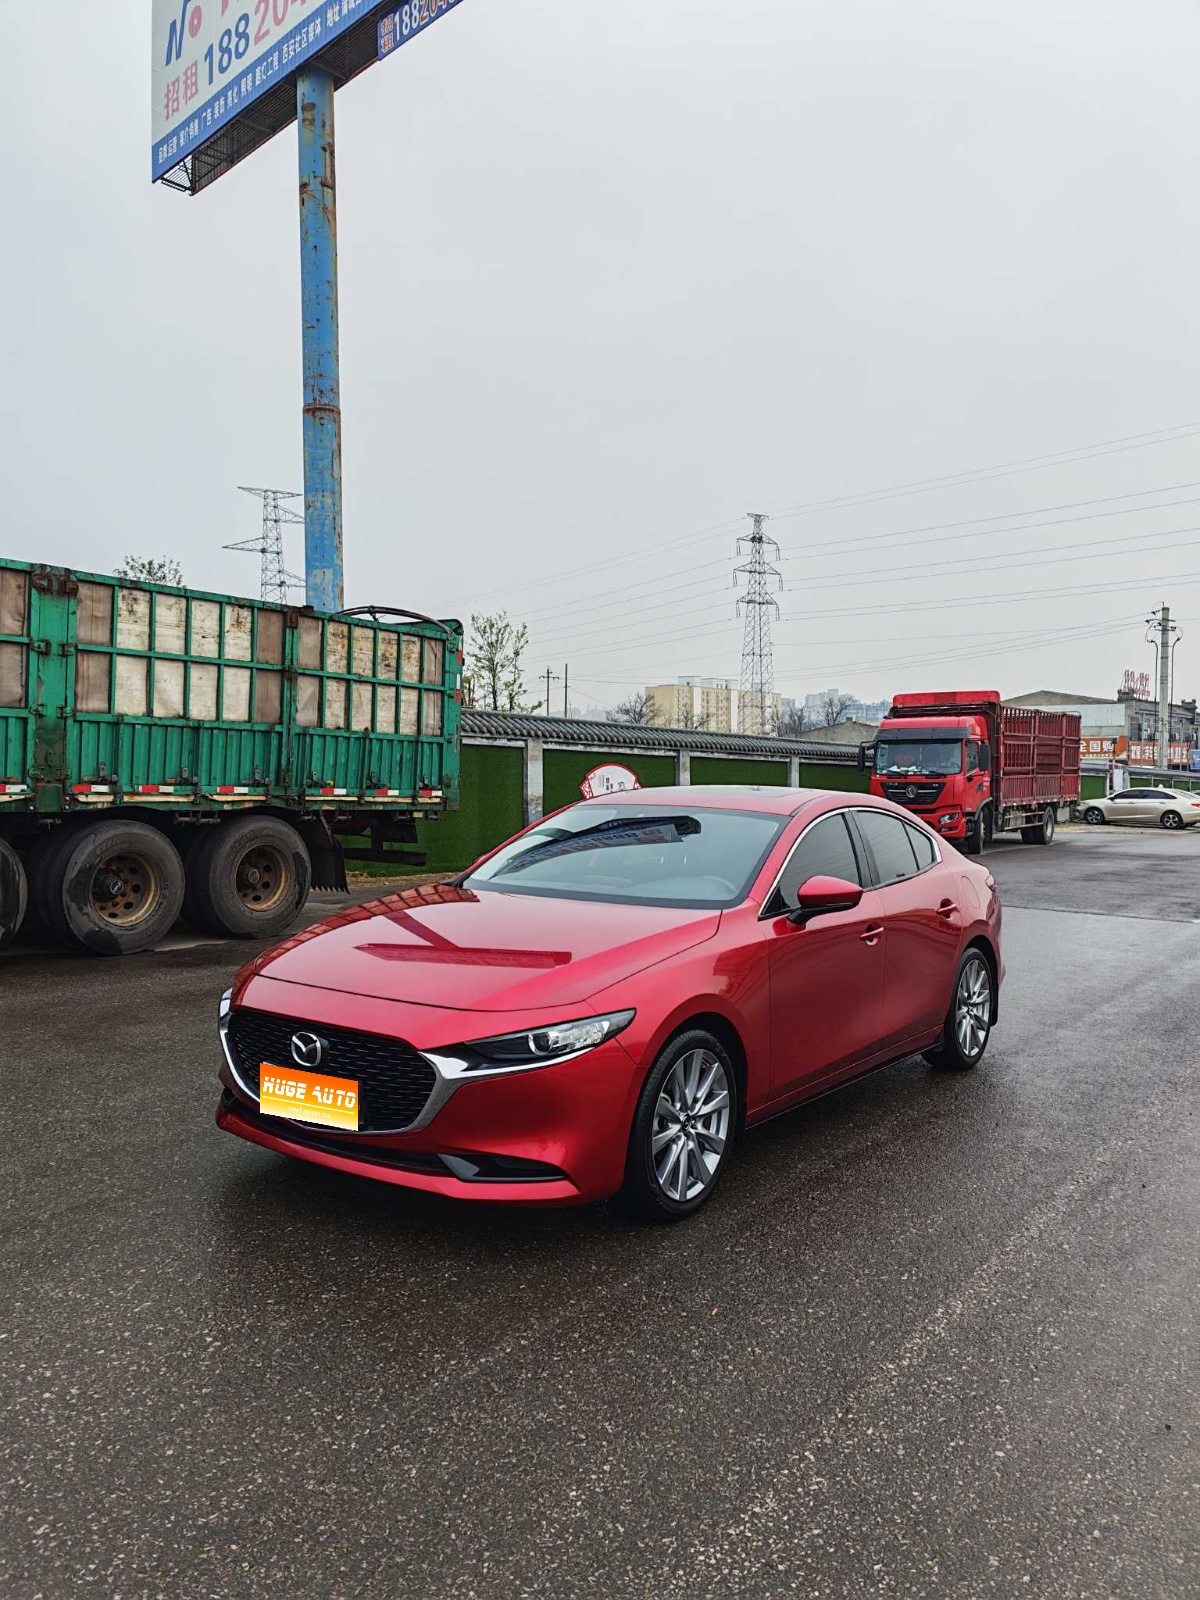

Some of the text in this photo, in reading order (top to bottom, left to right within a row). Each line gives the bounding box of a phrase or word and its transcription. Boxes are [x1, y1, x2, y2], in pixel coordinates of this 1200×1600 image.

[204, 0, 306, 86] 18820
[164, 60, 199, 121] 招租
[201, 108, 212, 130] 广告
